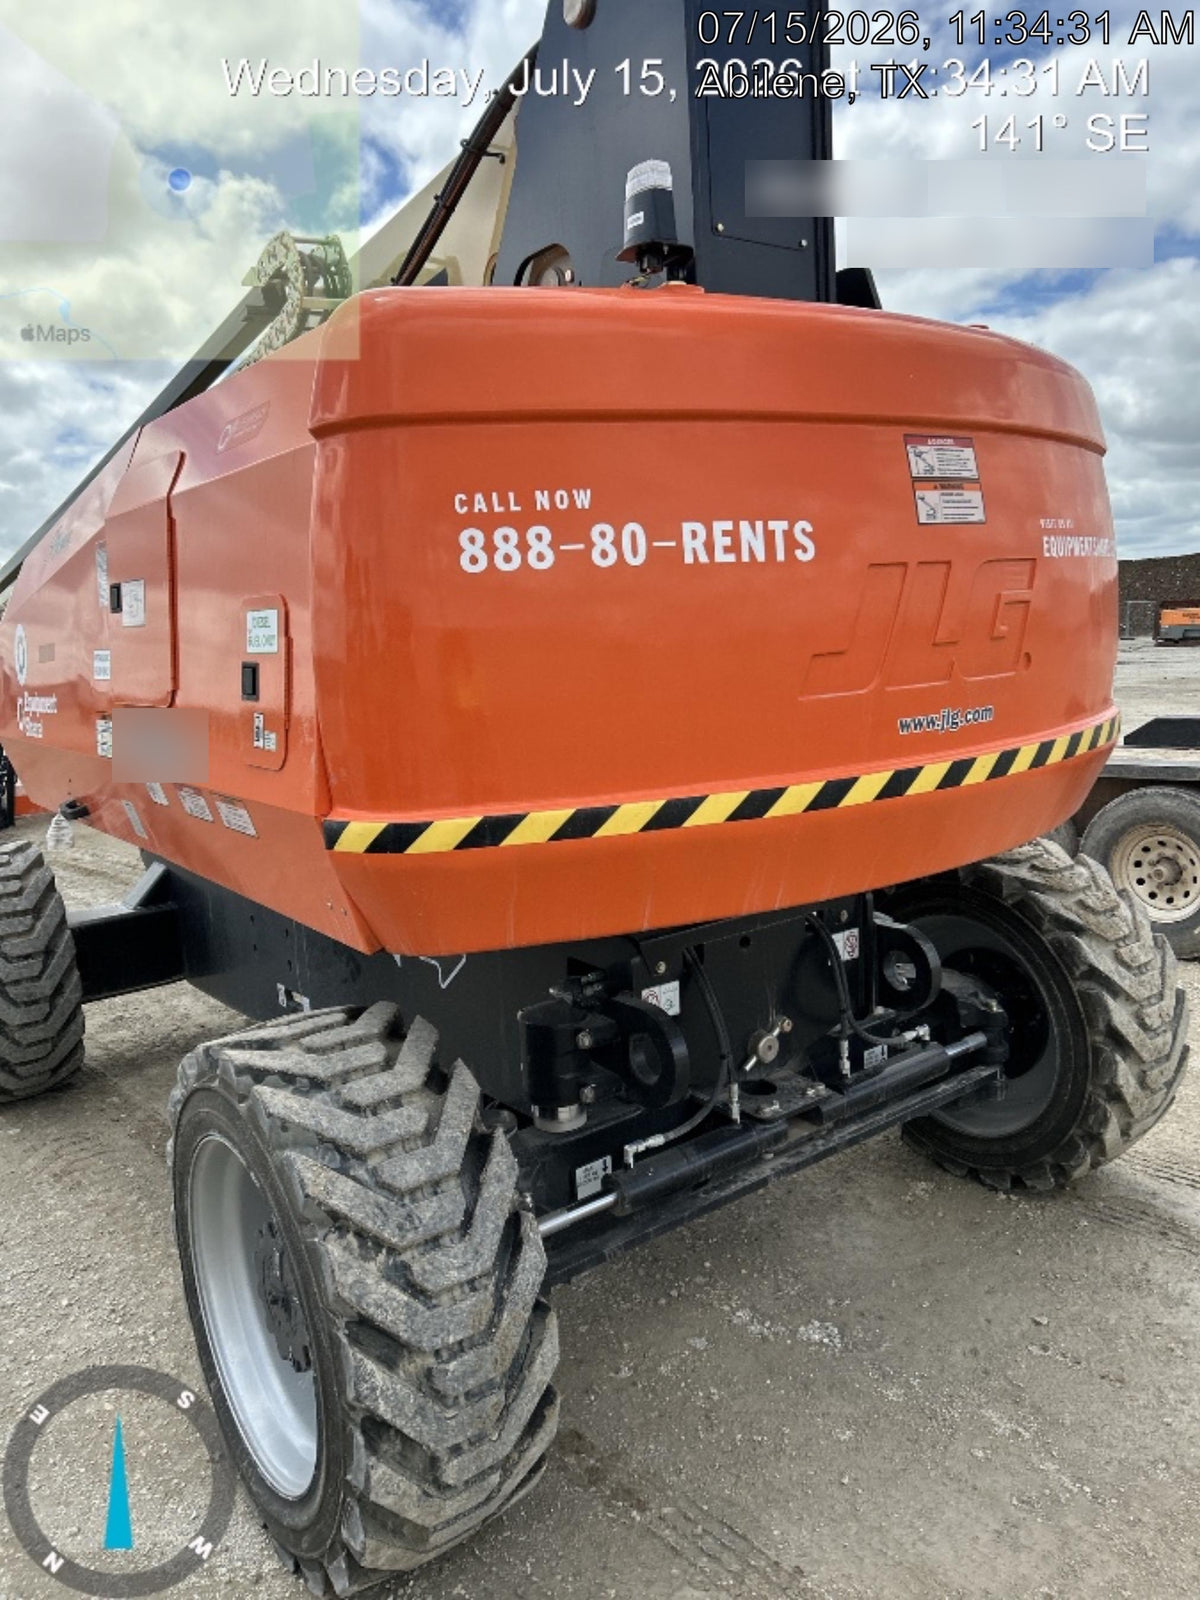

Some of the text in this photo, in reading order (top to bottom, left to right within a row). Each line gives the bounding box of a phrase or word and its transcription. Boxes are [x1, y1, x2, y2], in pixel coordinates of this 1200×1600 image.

[454, 488, 592, 514] CALL NOW
[458, 520, 816, 573] 888-80-RENTS
[798, 557, 1037, 701] JLG
[897, 705, 995, 735] www.jlg.com
